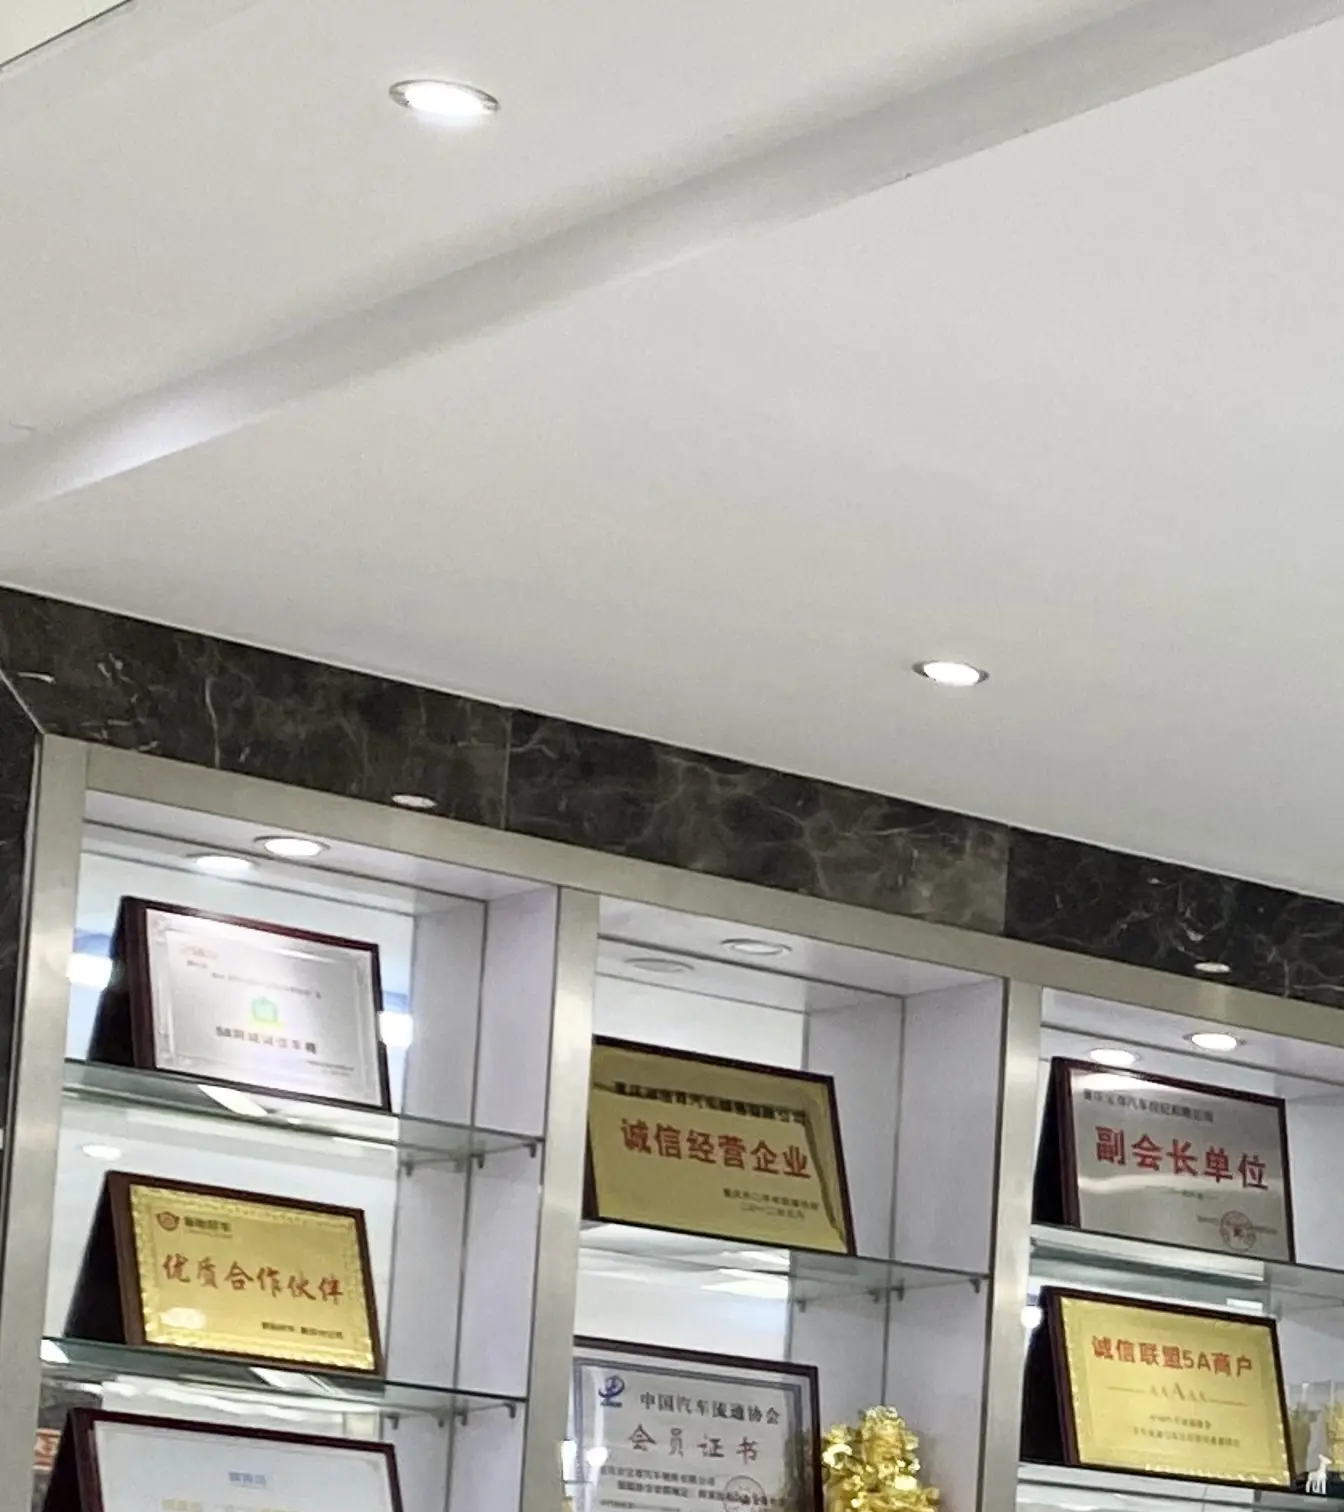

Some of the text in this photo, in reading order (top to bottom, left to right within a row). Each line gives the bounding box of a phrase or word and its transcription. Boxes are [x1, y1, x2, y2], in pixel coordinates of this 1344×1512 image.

[620, 1118, 811, 1179] 诚信经营企业
[1095, 1126, 1268, 1190] 副会长单位
[163, 1253, 344, 1305] 优质合作伙伴
[1092, 1335, 1252, 1378] 诚信联盟5A商户
[641, 1391, 781, 1425] 中国汽车流通协会
[629, 1423, 760, 1464] 会员证书
